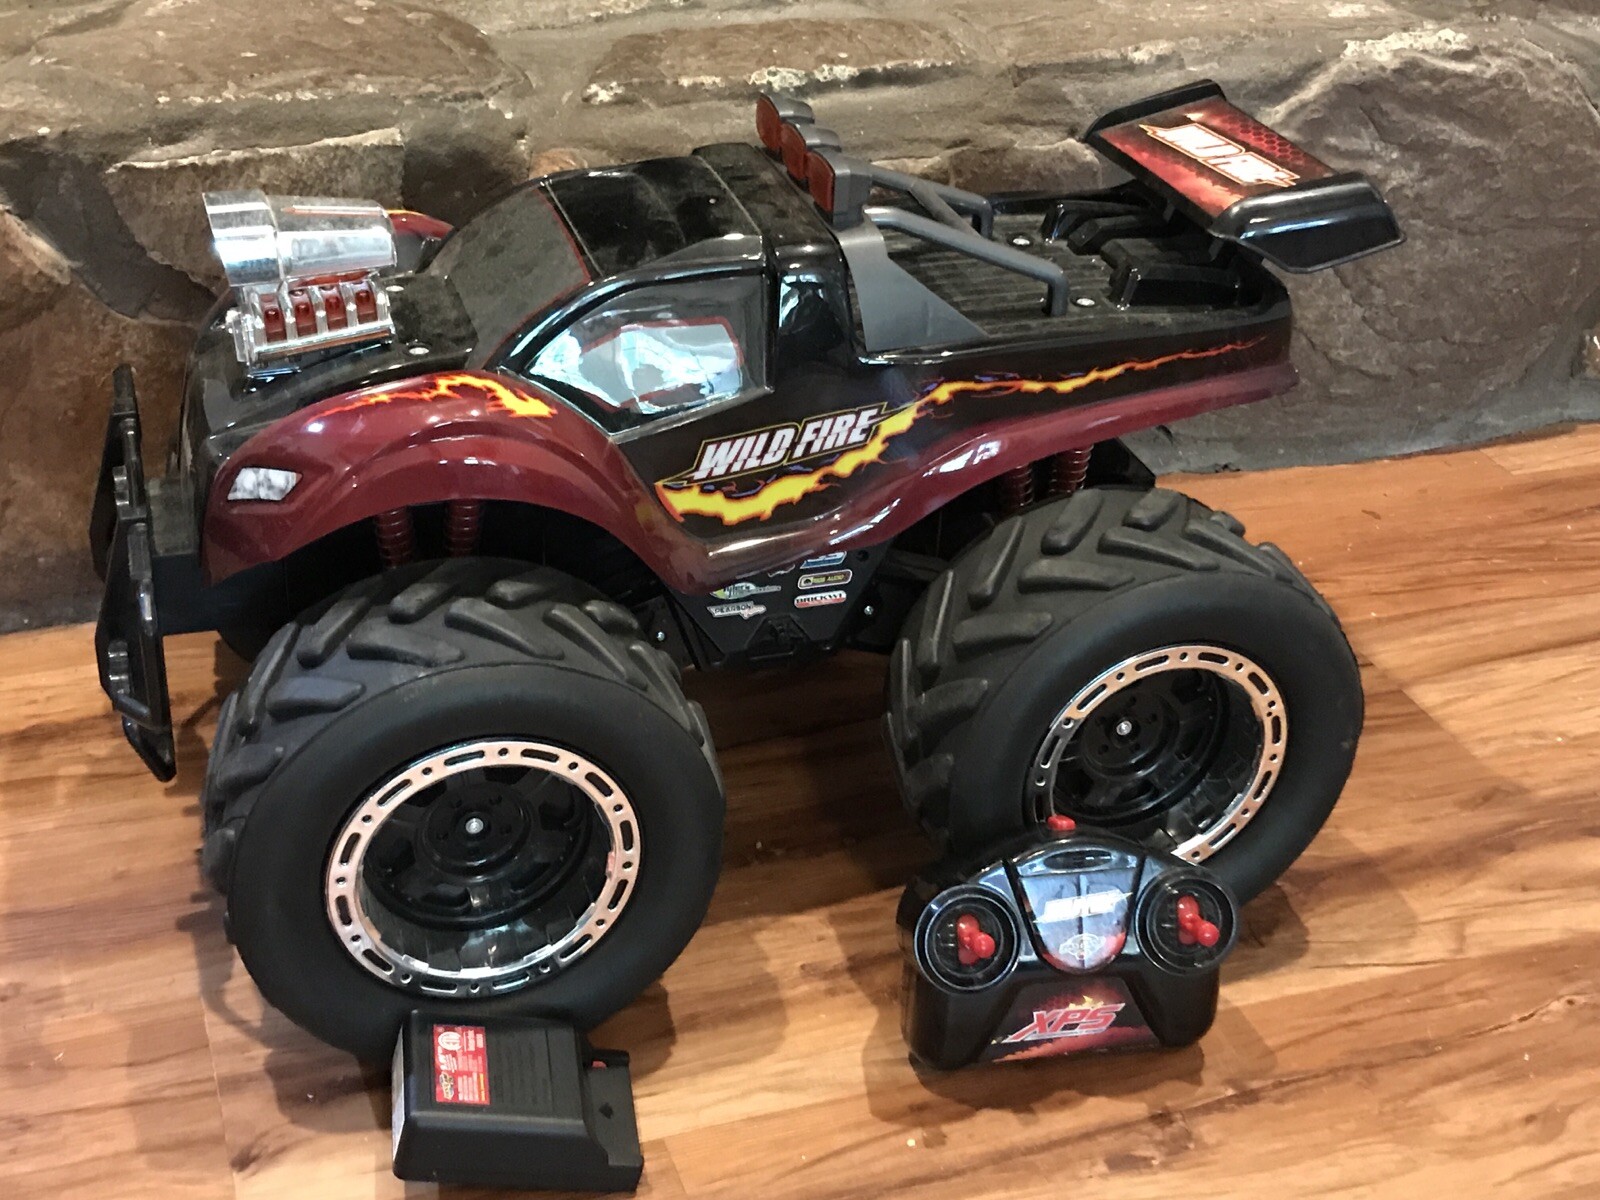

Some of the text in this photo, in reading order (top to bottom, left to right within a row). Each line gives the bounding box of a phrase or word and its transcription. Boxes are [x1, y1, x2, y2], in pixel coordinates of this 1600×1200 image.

[689, 408, 885, 481] WILD FIRE
[1002, 1003, 1125, 1043] XPS
